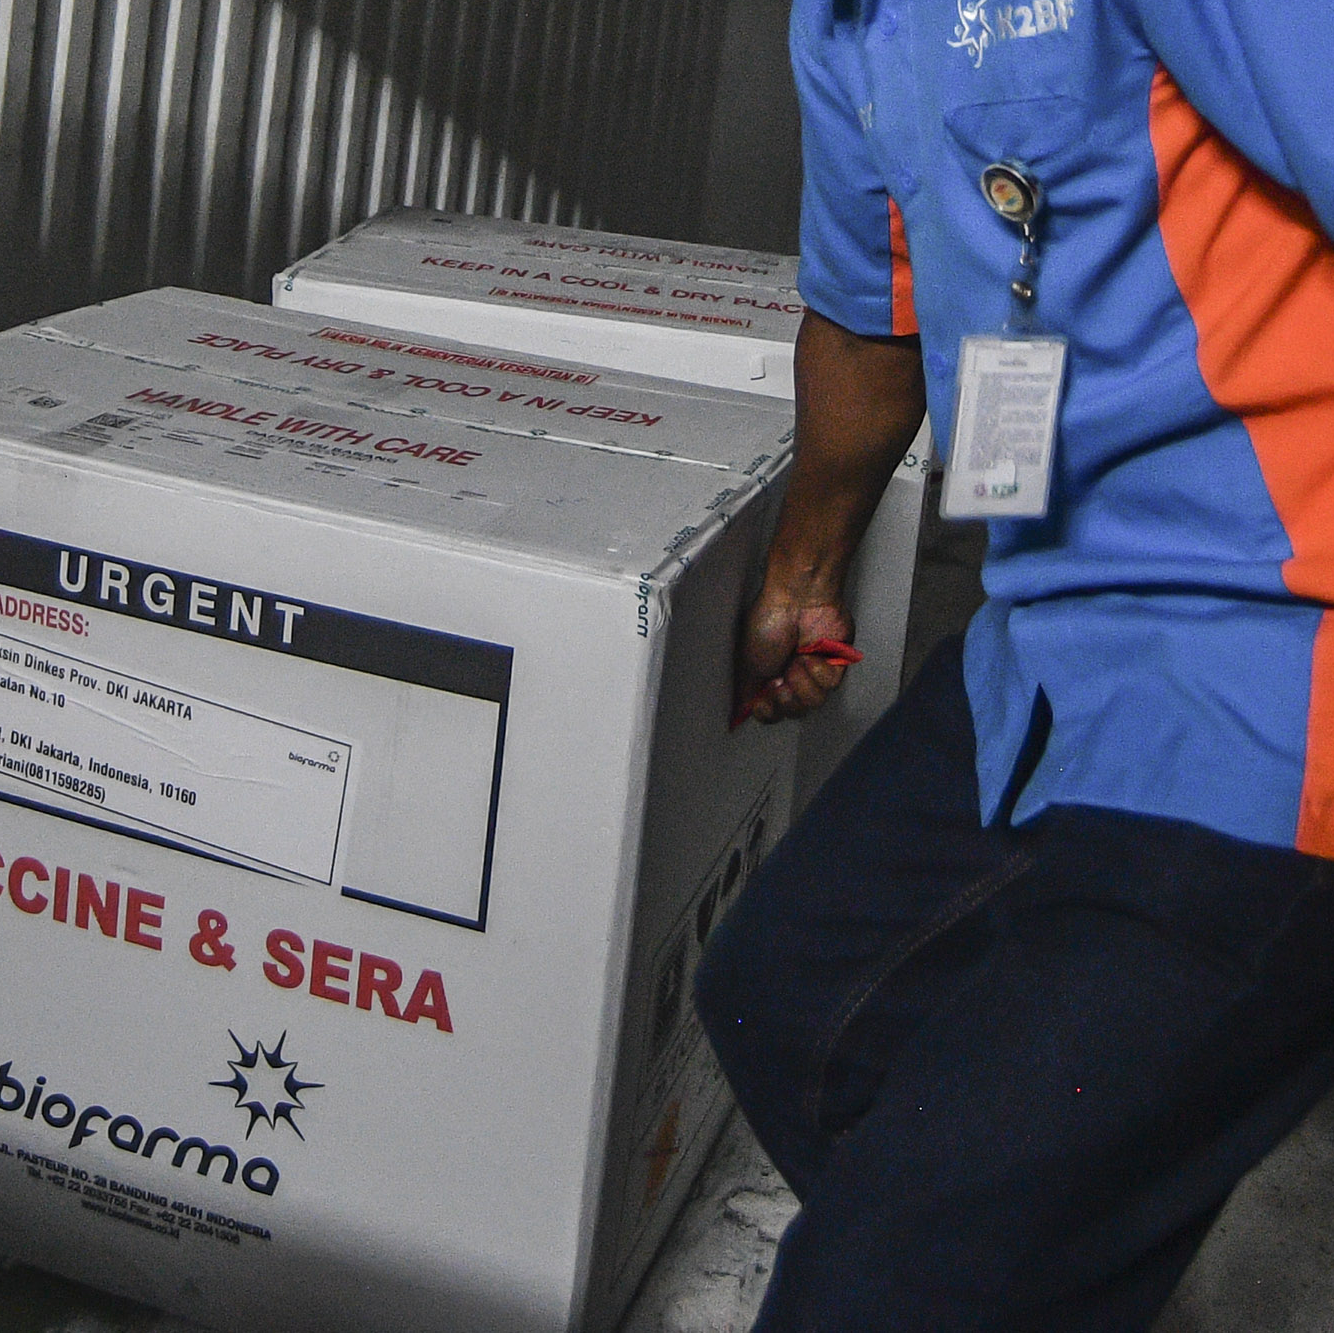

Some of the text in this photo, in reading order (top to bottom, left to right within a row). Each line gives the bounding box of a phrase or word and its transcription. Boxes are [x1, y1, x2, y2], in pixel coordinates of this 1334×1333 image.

[421, 256, 495, 273] KEEP
[500, 267, 529, 279] IN
[532, 272, 552, 282] A
[559, 274, 634, 294] COOL
[643, 285, 661, 297] &
[670, 288, 726, 304] DRY
[186, 332, 299, 363] PLACE
[292, 356, 366, 374] DRY
[367, 368, 397, 380] &
[404, 373, 494, 398] COOL
[496, 390, 527, 402] A
[527, 395, 568, 410] IN
[567, 405, 663, 428] KEEP
[125, 388, 278, 426] HANDLE
[275, 416, 373, 445] WITH
[373, 437, 483, 467] CARE
[58, 550, 305, 644] URGENT
[24, 653, 66, 680] Dinkes
[69, 670, 102, 693] Prov.
[106, 680, 130, 702] DKI
[132, 688, 193, 722] JAKARTA
[10, 730, 33, 750] DKI
[35, 740, 85, 770] Jakarta,
[88, 757, 153, 794] Indonesia,
[158, 781, 197, 807] 10160
[288, 751, 336, 773] biofarma
[188, 908, 237, 971] &
[262, 928, 454, 1034] SERA
